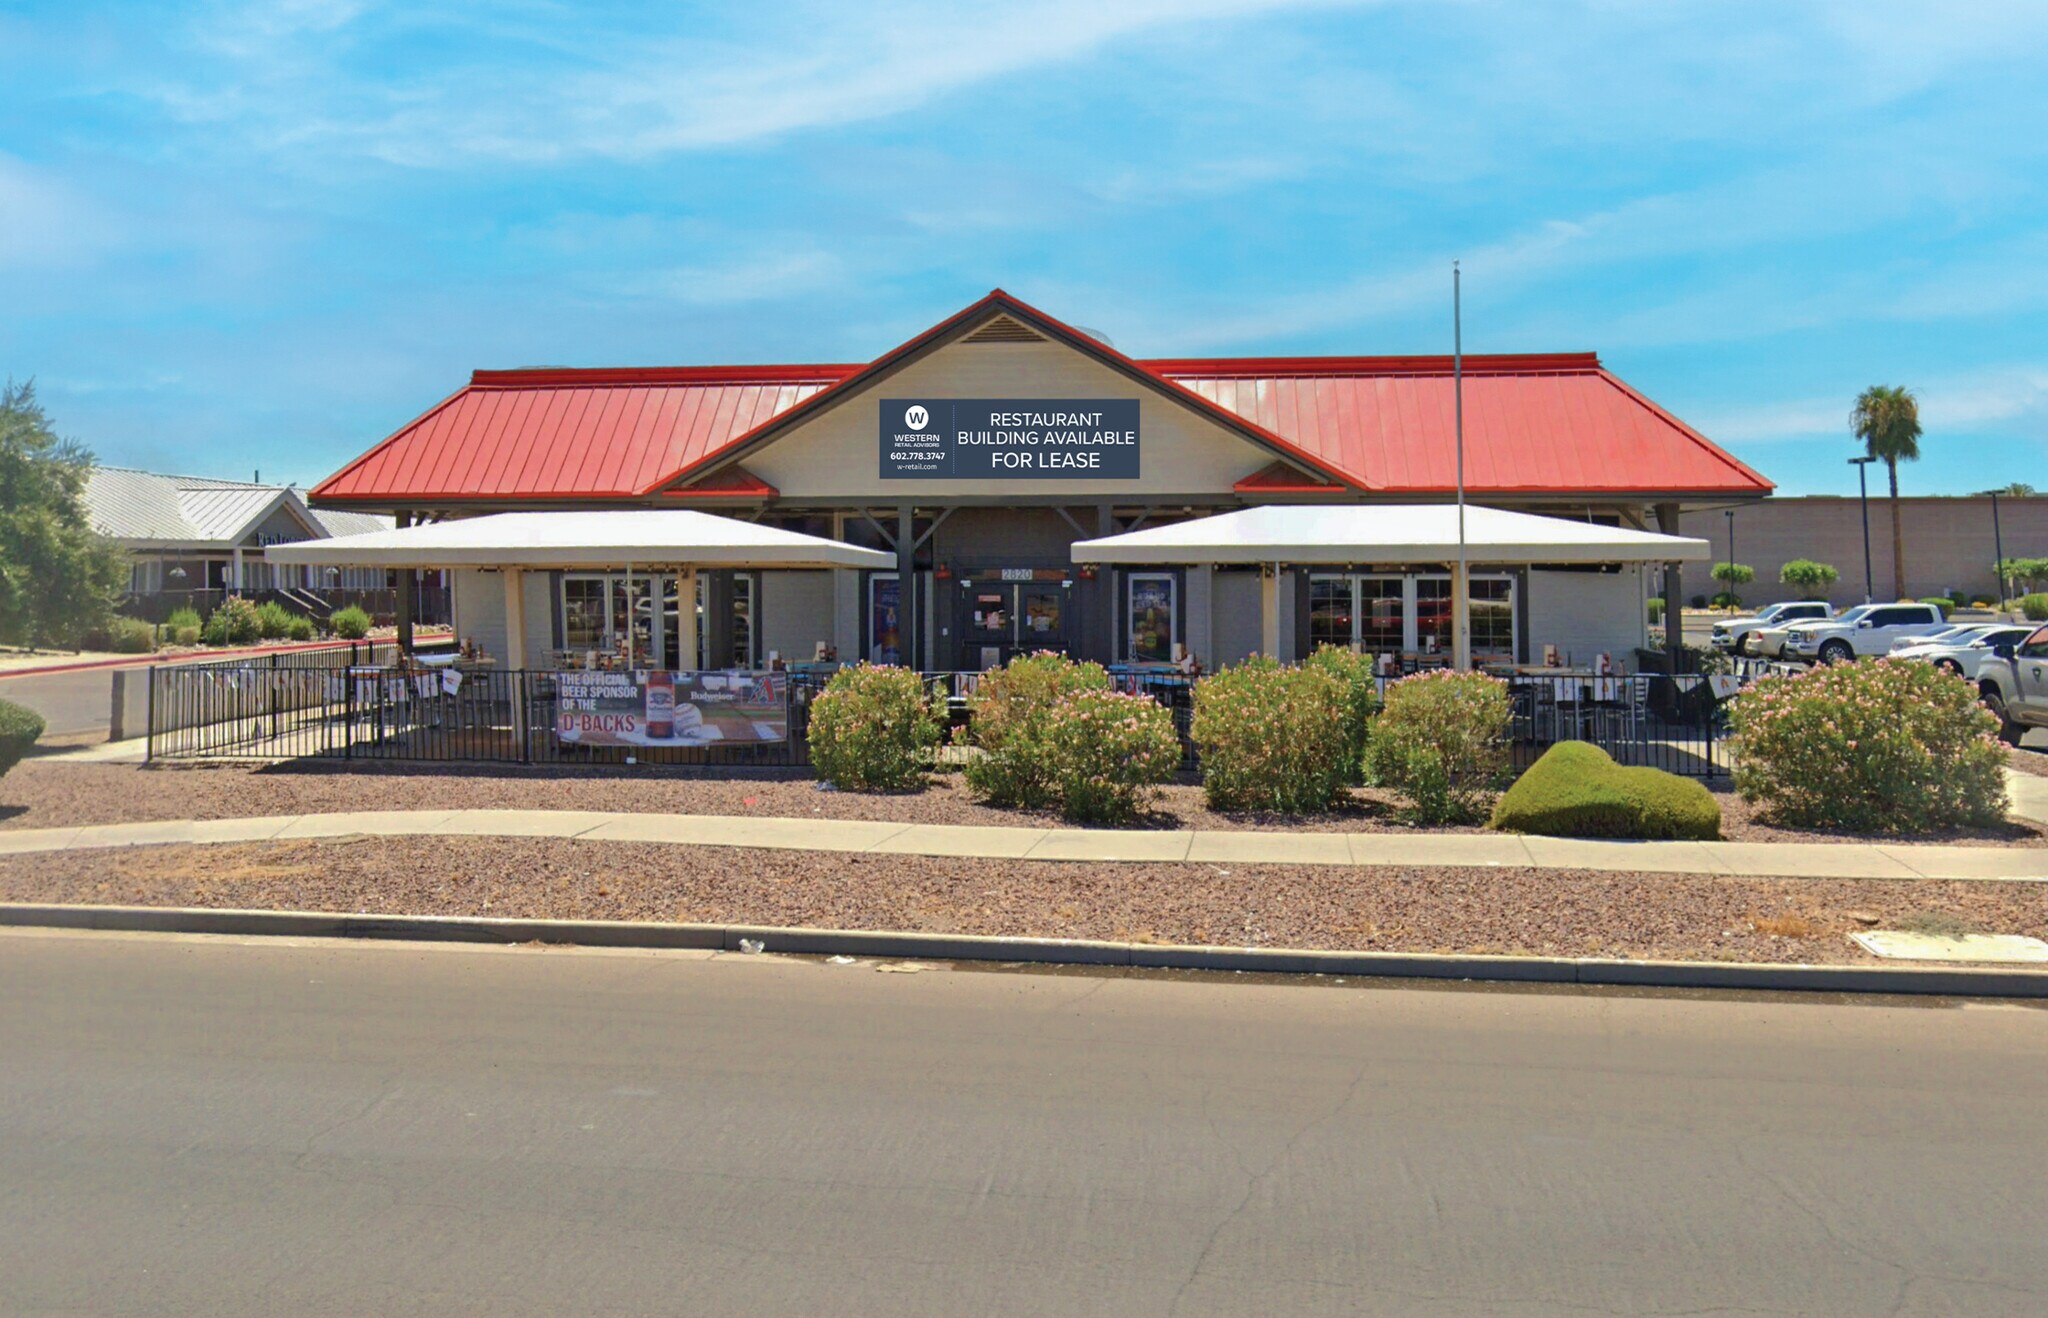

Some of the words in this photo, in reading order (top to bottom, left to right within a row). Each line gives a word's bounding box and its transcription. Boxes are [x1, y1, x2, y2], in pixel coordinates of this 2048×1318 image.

[909, 412, 925, 424] W
[990, 413, 1102, 427] RESTAURANT
[894, 434, 940, 442] WESTERN
[958, 431, 1039, 445] BUILDING
[1043, 431, 1135, 445] AVAILABLE
[890, 452, 946, 460] 602.778.3747
[992, 452, 1032, 469] FOR
[1039, 452, 1101, 469] LEASE
[896, 462, 937, 470] w-retail.com
[1003, 570, 1032, 580] 2820
[561, 673, 580, 685] THE
[583, 674, 628, 686] OFFICIAL
[561, 686, 588, 698] BEER
[590, 686, 638, 698] SPONSOR
[690, 690, 735, 703] Budweiser
[562, 699, 576, 710] OF
[577, 699, 597, 711] THE
[563, 714, 635, 733] D-BACKS
